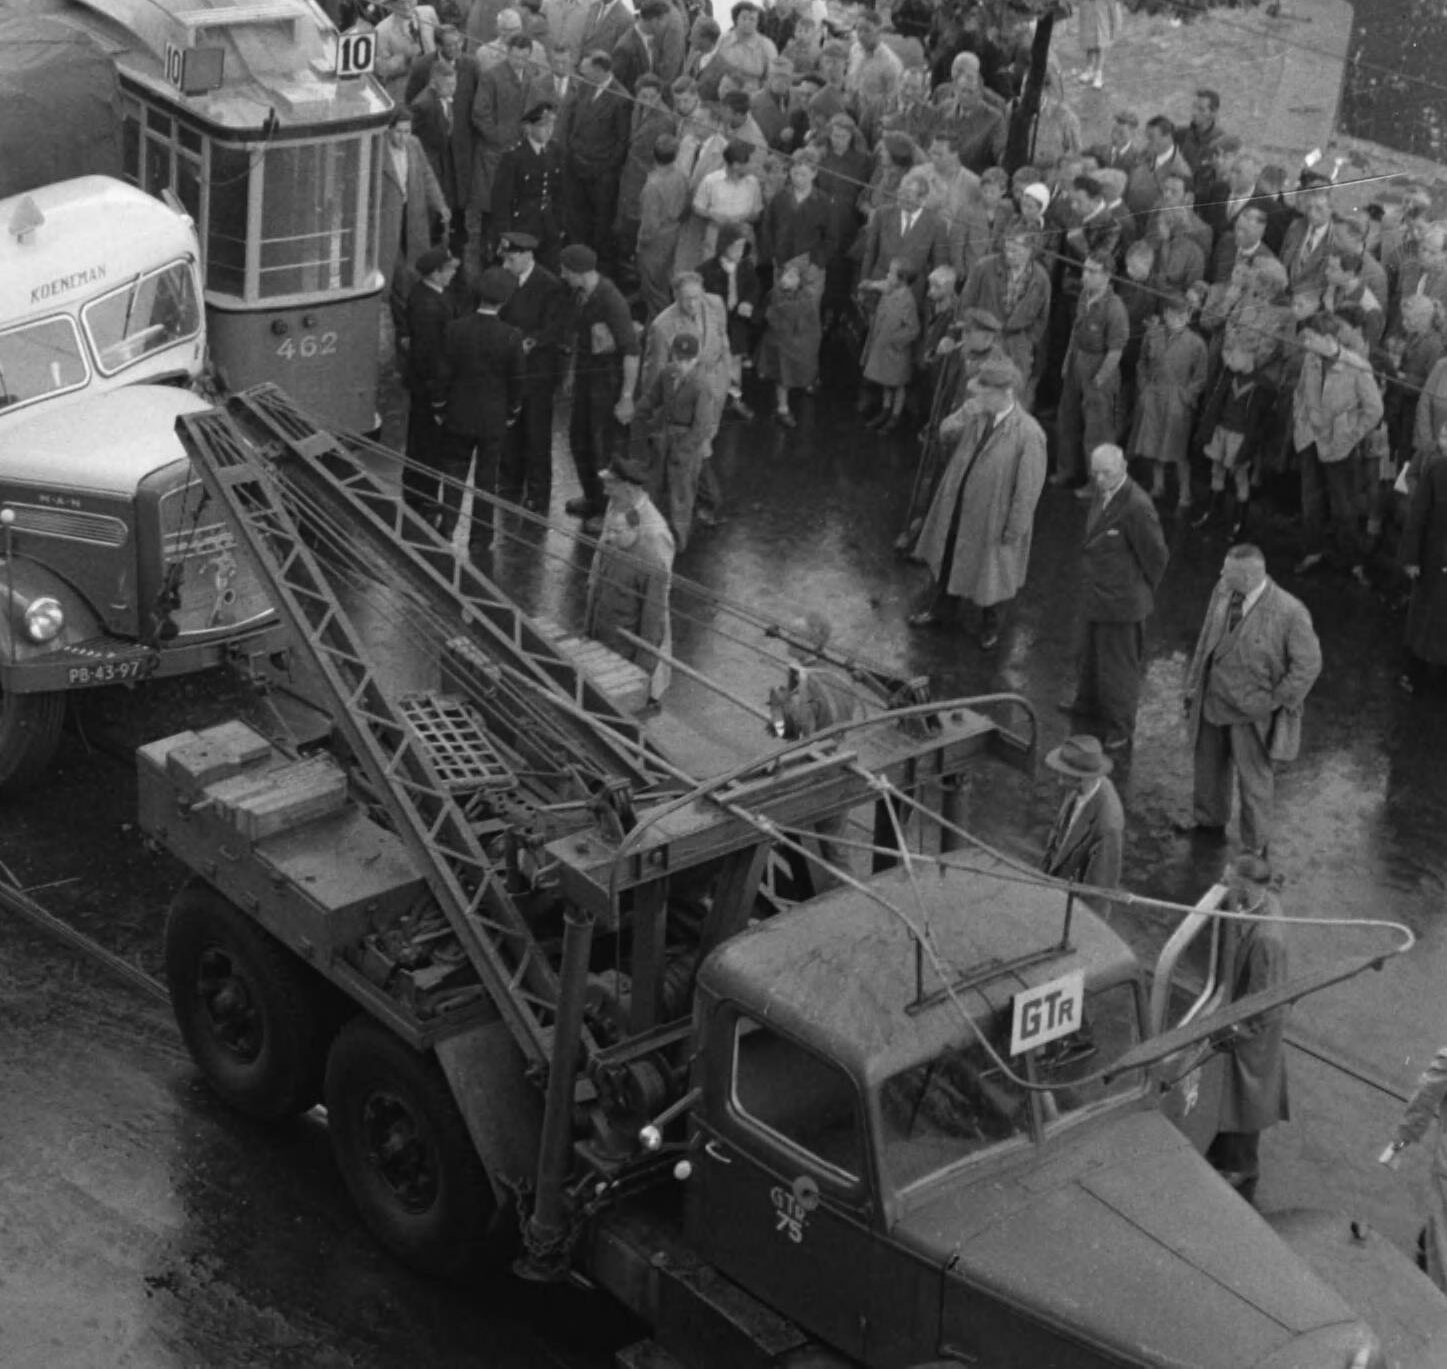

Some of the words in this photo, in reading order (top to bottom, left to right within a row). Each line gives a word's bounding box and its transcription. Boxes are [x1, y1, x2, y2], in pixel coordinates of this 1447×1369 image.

[167, 47, 182, 83] 10
[342, 36, 373, 72] 10
[30, 264, 107, 304] KOENEMAN
[276, 332, 339, 360] 462
[68, 661, 140, 684] PB-43-97
[1020, 990, 1074, 1041] GTR
[776, 1210, 803, 1244] 75
